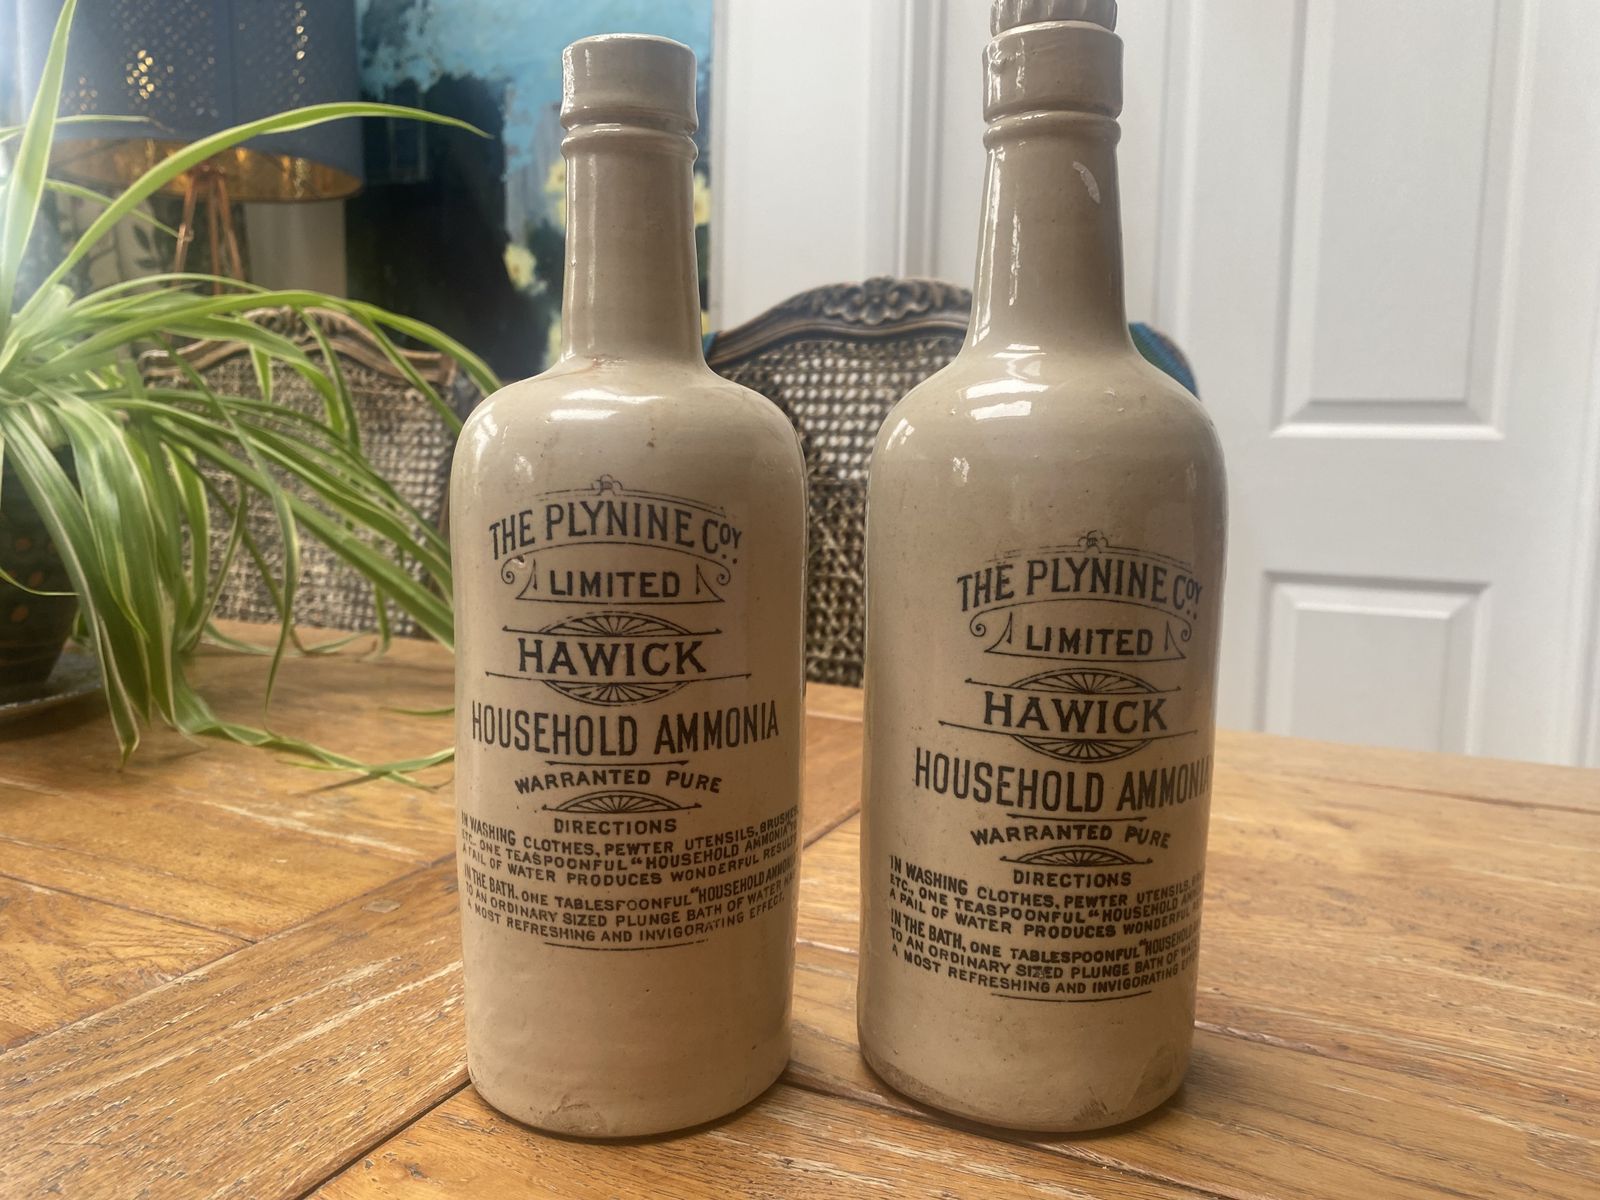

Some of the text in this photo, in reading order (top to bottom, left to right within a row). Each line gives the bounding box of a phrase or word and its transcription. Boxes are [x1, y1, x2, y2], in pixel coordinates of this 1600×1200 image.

[489, 510, 536, 560] THE
[545, 500, 695, 547] PLYNINE
[550, 570, 680, 597] LIMITED
[957, 564, 1014, 612] THE
[1026, 557, 1167, 601] PLYNINE
[518, 638, 707, 676] HAWICK
[1026, 625, 1153, 656] LIMITED
[472, 700, 780, 756] HOUSEHOLD AMMONIA
[984, 691, 1168, 733] HAWICK
[514, 769, 722, 794] WARRANTED PURE
[916, 747, 1104, 813] HOUSEHOLD
[470, 816, 516, 845] WASHING
[523, 836, 600, 857] CLOTHES,
[604, 841, 673, 856] PEWTER
[554, 818, 677, 835] DIRECTIONS
[970, 824, 1171, 849] WARRANTED PURE
[480, 840, 501, 857] ONE
[506, 848, 628, 871] TEASPOONFUL
[490, 857, 502, 870] OF
[508, 863, 556, 882] WATER
[567, 872, 662, 886] PRODUCES
[671, 854, 759, 882] WONDERFUL
[465, 864, 471, 880] IN
[472, 866, 487, 894] THE
[522, 890, 548, 906] ONE
[891, 856, 901, 873] IN
[906, 862, 968, 896] WASHING
[977, 886, 1060, 909] CLOTHES,
[1064, 895, 1128, 908] PEWTER
[1014, 869, 1132, 888] DIRECTIONS
[465, 879, 781, 927] TO AN ORDINARY SIZED PLUNGE BATH OF WATER
[475, 903, 501, 924] MOST
[507, 917, 595, 941] REFRESHING
[601, 931, 632, 942] AND
[640, 912, 744, 941] INVIGORATING
[890, 888, 896, 900] A
[900, 893, 926, 914] PAIL
[932, 906, 949, 919] OF
[955, 912, 1012, 934] WATER
[1024, 924, 1116, 939] PRODUCES
[1123, 910, 1190, 935] WONDERFUL
[919, 887, 948, 905] ONE
[954, 897, 1085, 923] TEASPOONFUL
[891, 909, 901, 927] IN
[903, 914, 925, 938] THE
[929, 925, 966, 952] BATH,
[970, 941, 1002, 957] ONE
[1010, 948, 1140, 963] TABLESPOONFUL
[891, 927, 1178, 979] TO AN ORDINARY SIZED PLUNGE BATH OF
[892, 944, 898, 956] A
[904, 951, 941, 973] MOST
[948, 967, 1050, 993] REFRESHING
[1056, 983, 1086, 993] AND
[1093, 963, 1178, 993] INVIGORATING
